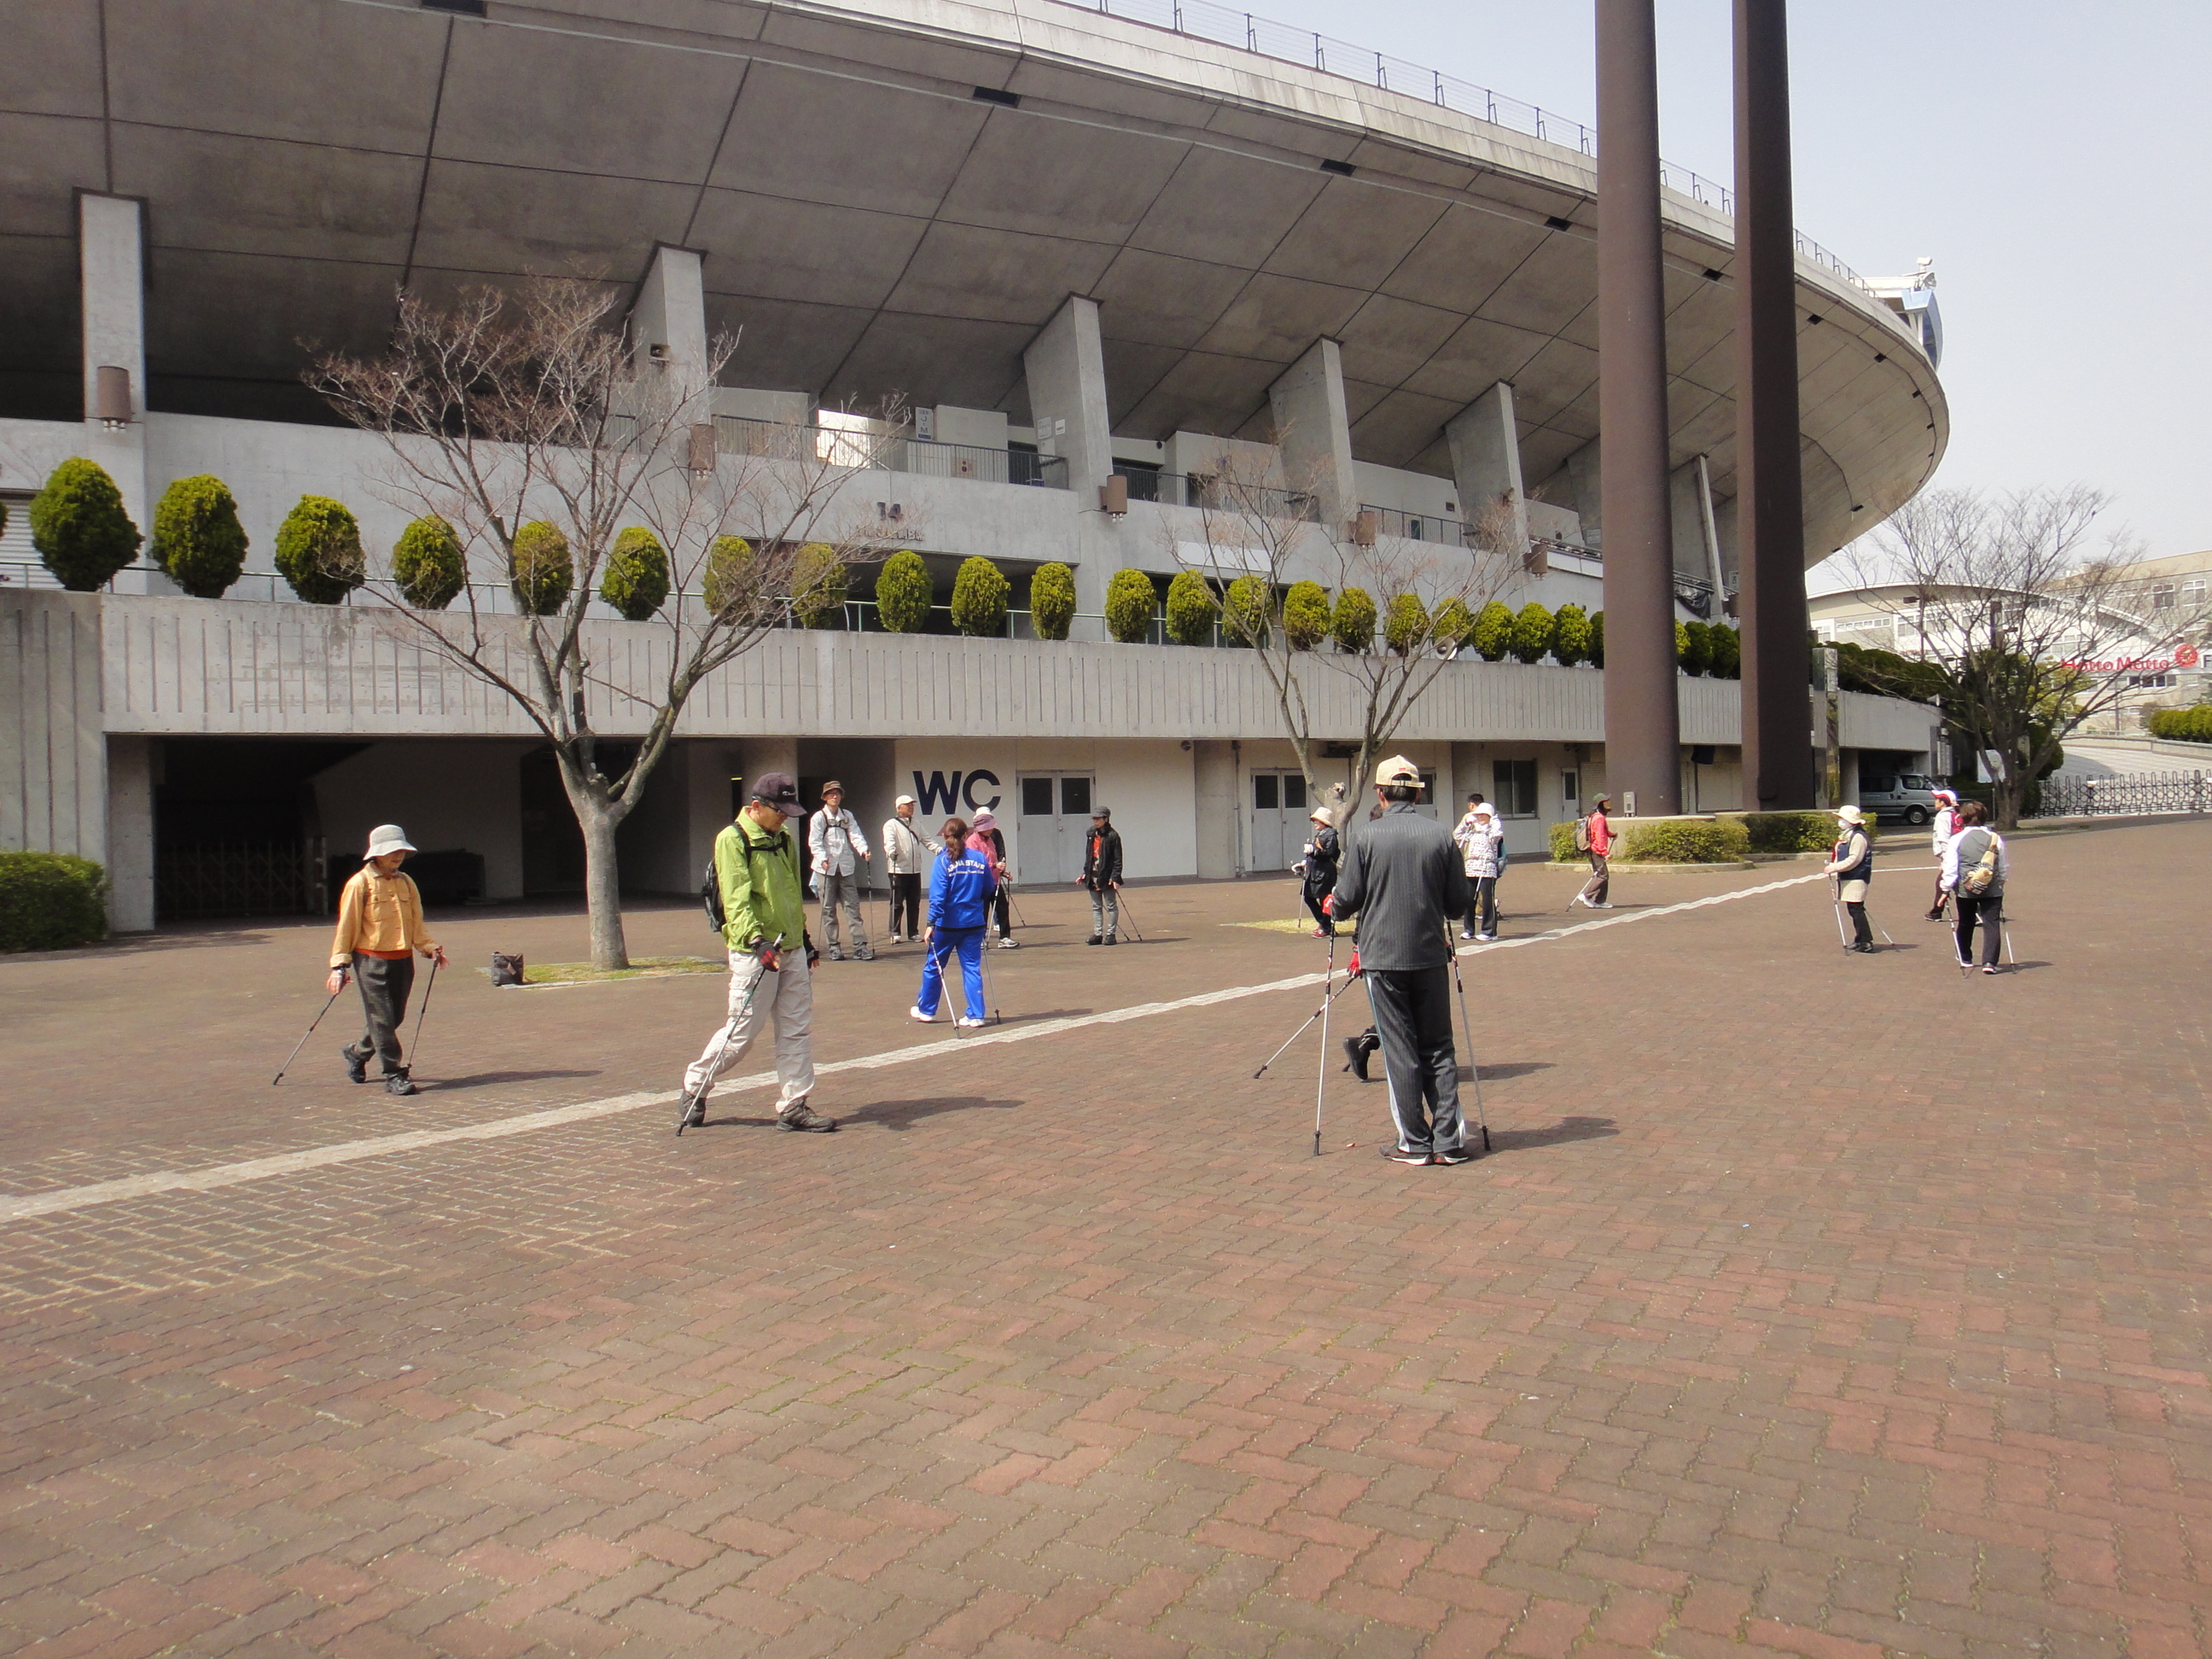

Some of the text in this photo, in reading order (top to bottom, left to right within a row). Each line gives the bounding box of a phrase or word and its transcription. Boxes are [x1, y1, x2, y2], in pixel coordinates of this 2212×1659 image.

[877, 502, 901, 521] 14
[2061, 659, 2114, 672] Hotto
[2116, 656, 2169, 671] Motto
[912, 769, 1001, 815] WC
